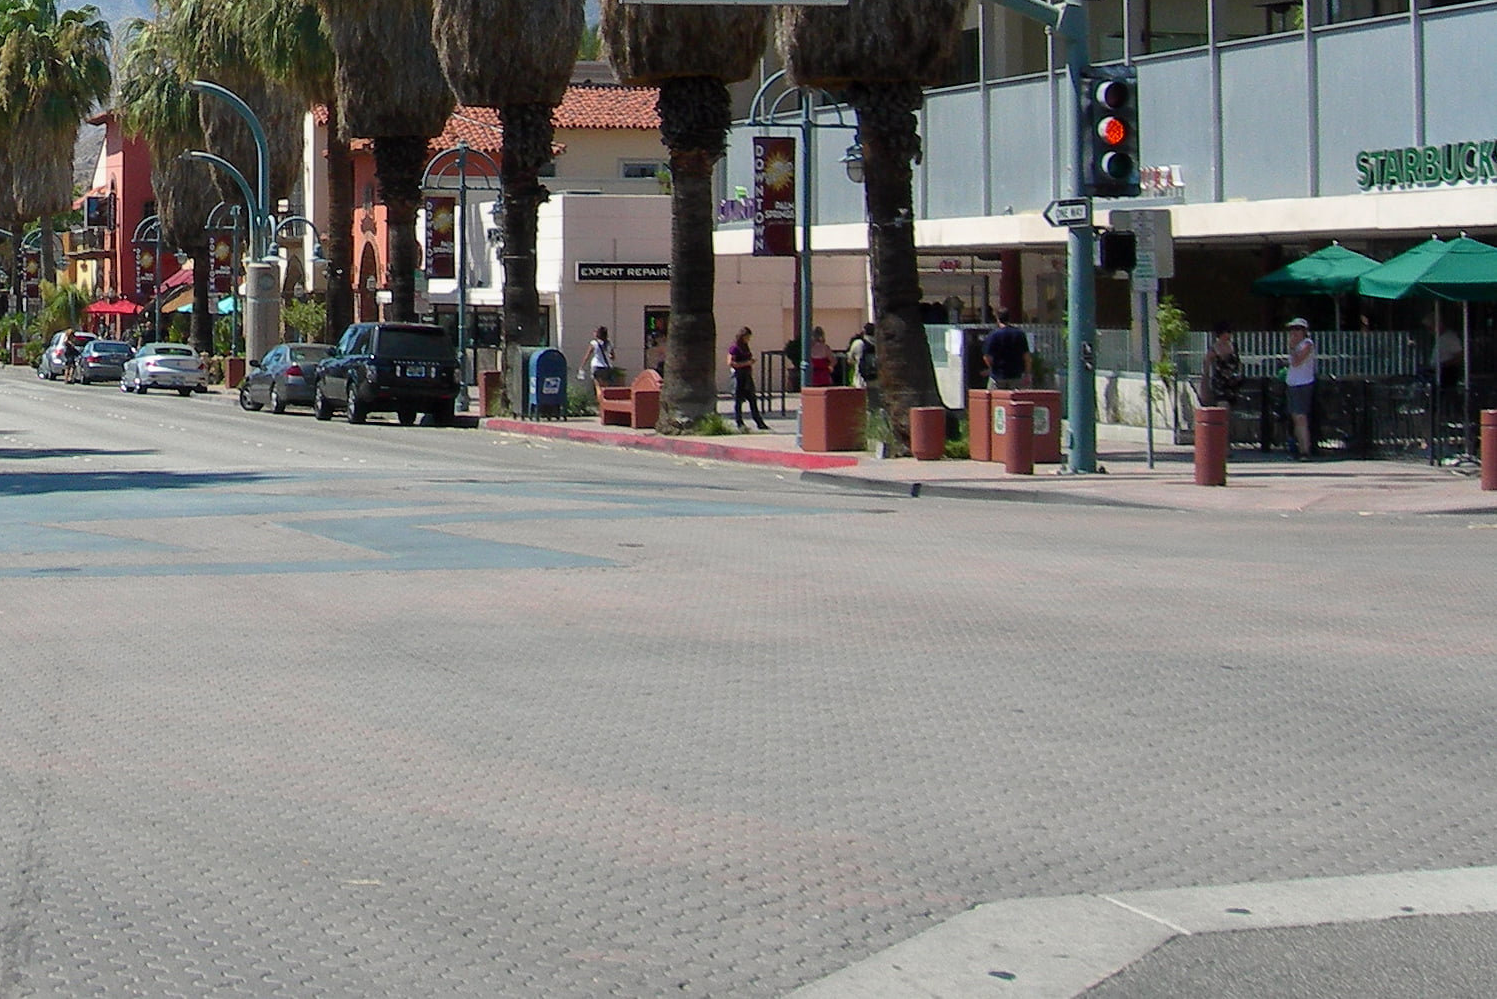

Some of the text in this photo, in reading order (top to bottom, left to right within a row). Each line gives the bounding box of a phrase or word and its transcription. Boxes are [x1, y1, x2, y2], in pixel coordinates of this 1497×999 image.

[755, 145, 764, 251] DOWNTOWN
[764, 209, 794, 219] SPRINGS
[1055, 208, 1069, 219] ONE
[581, 267, 624, 277] EXPERT
